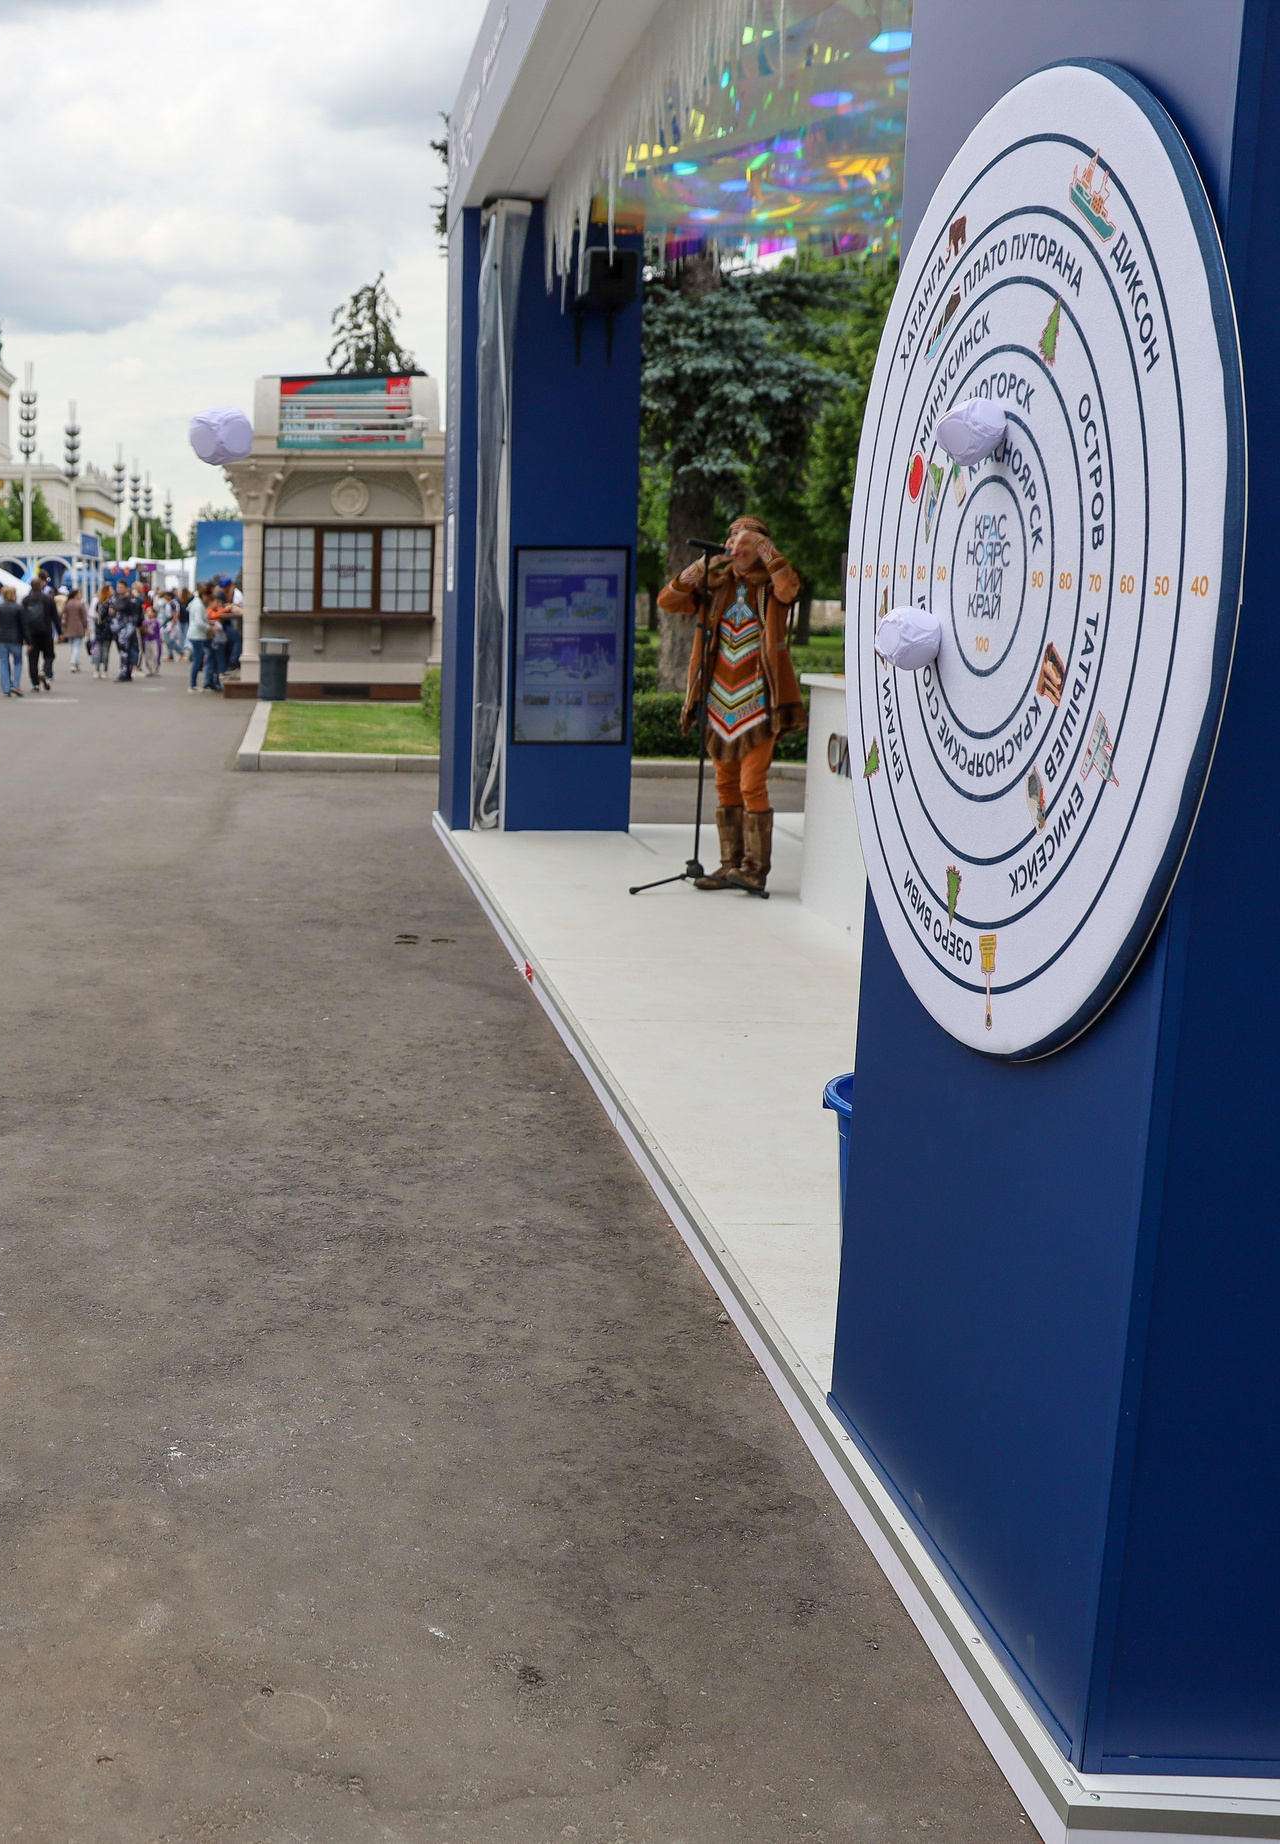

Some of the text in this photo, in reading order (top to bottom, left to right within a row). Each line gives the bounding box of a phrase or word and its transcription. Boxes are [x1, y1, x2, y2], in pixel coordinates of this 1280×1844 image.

[963, 233, 1083, 298] ПЛАТО ПУТОРАНА
[1110, 231, 1160, 373] ДИКСОН
[900, 256, 946, 371] ХАТАНГА
[920, 310, 991, 453] МИНУСИНСК
[968, 438, 1043, 555] КАСНОЯРСК
[974, 513, 1008, 541] КРАС
[849, 564, 947, 581] 40 50 60 70 80 90
[965, 540, 1011, 568] НОЯРС
[975, 565, 1004, 594] КИЙ
[1031, 571, 1209, 597] 90 80 70 60 50 40
[1044, 393, 1105, 783] ОСТРОВ ТАТЫШЕВ
[967, 592, 1002, 621] КРАЙ
[975, 636, 990, 653] 100
[827, 732, 852, 780] СИ
[882, 677, 904, 784] ЕРГАКИ
[937, 695, 1042, 778] КРАСНОЯРСКИЕ
[1010, 782, 1085, 897] ЕНИСЕЙСК
[903, 869, 973, 966] ОЗЕРО ВИВИ
